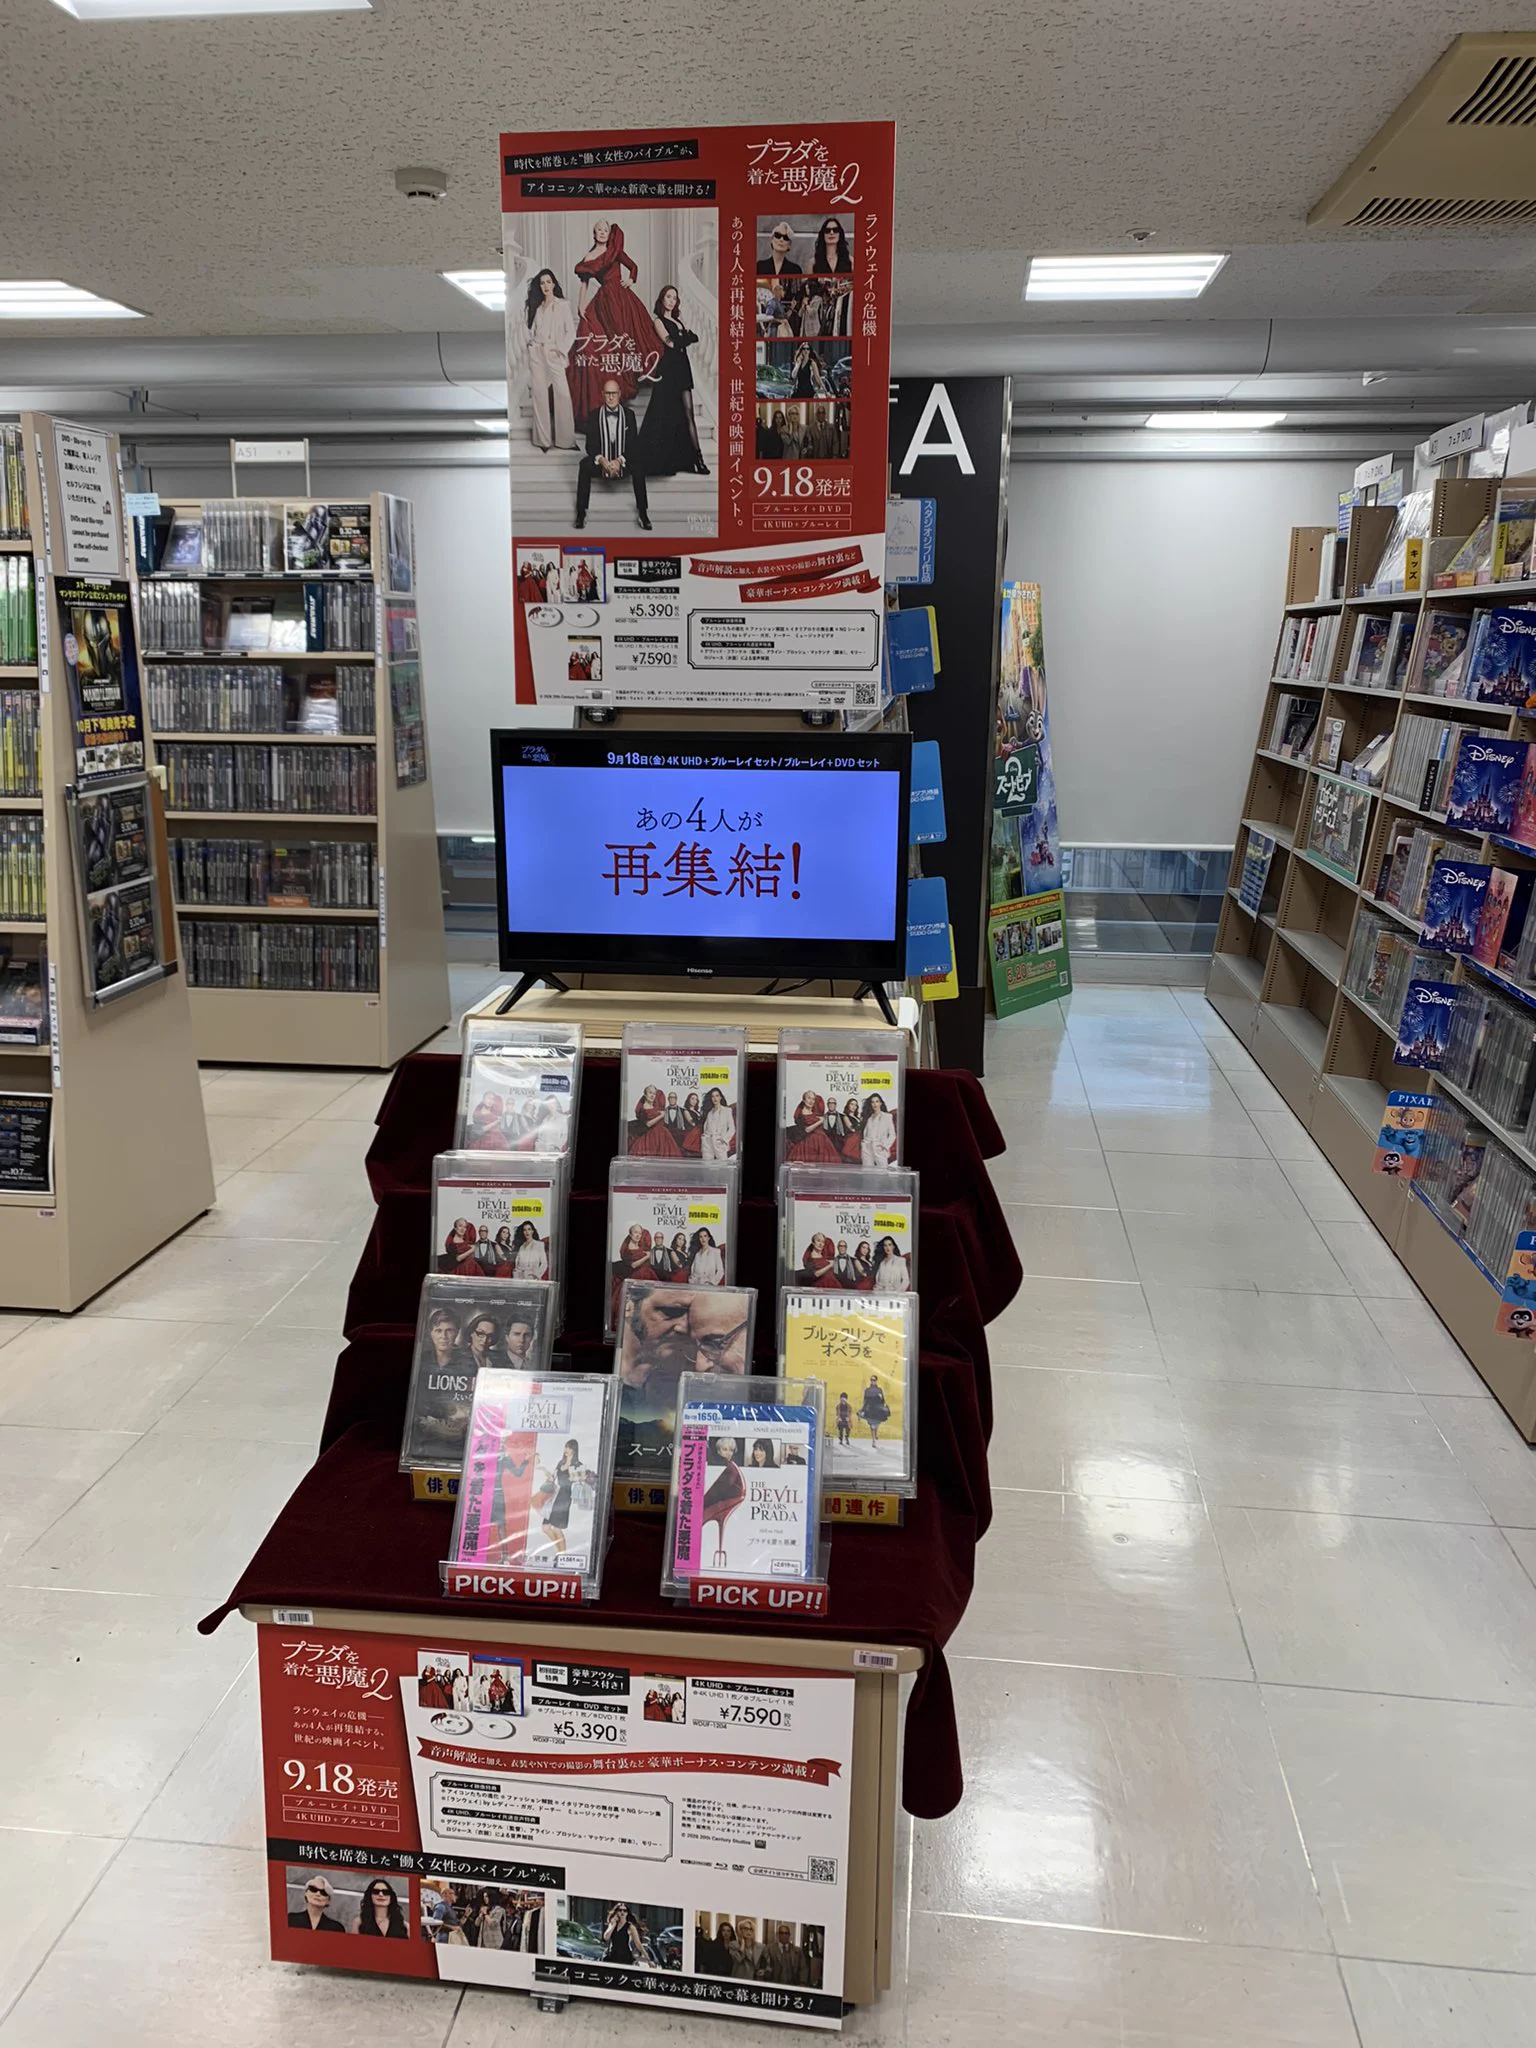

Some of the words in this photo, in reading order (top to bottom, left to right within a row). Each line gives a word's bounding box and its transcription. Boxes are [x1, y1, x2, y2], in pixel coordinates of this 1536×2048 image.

[746, 138, 829, 165] プラダを
[747, 162, 863, 205] 着た悪魔2
[574, 333, 636, 354] プラダを
[574, 350, 662, 383] 着た悪魔2
[899, 384, 976, 475] A
[753, 466, 852, 498] 9.18発売
[636, 796, 764, 834] あの4人が
[602, 841, 803, 901] 再集結!
[667, 1066, 695, 1077] DEVIL
[826, 1072, 857, 1082] DEVIL
[478, 1199, 509, 1209] DEVIL
[653, 1205, 684, 1216] DEVIL
[836, 1213, 869, 1224] DEVIL
[803, 1326, 887, 1345] ブルックリンで
[428, 1374, 468, 1391] LIONS
[698, 1412, 718, 1422] 1650
[677, 1443, 696, 1561] プラダを着た悪魔
[750, 1485, 801, 1504] DEVIL
[750, 1505, 798, 1522] PRADA
[454, 1575, 515, 1596] PICK
[524, 1579, 577, 1599] UP!!
[697, 1584, 760, 1605] PICK
[768, 1588, 822, 1610] UP!!
[281, 1640, 359, 1665] プラダを
[283, 1661, 393, 1701] 着た悪魔2
[720, 1704, 781, 1727] ¥7,590
[294, 1733, 385, 1751] 世紀の映画イベント。
[553, 1721, 617, 1742] ¥5,390
[283, 1759, 398, 1799] 9.18発売
